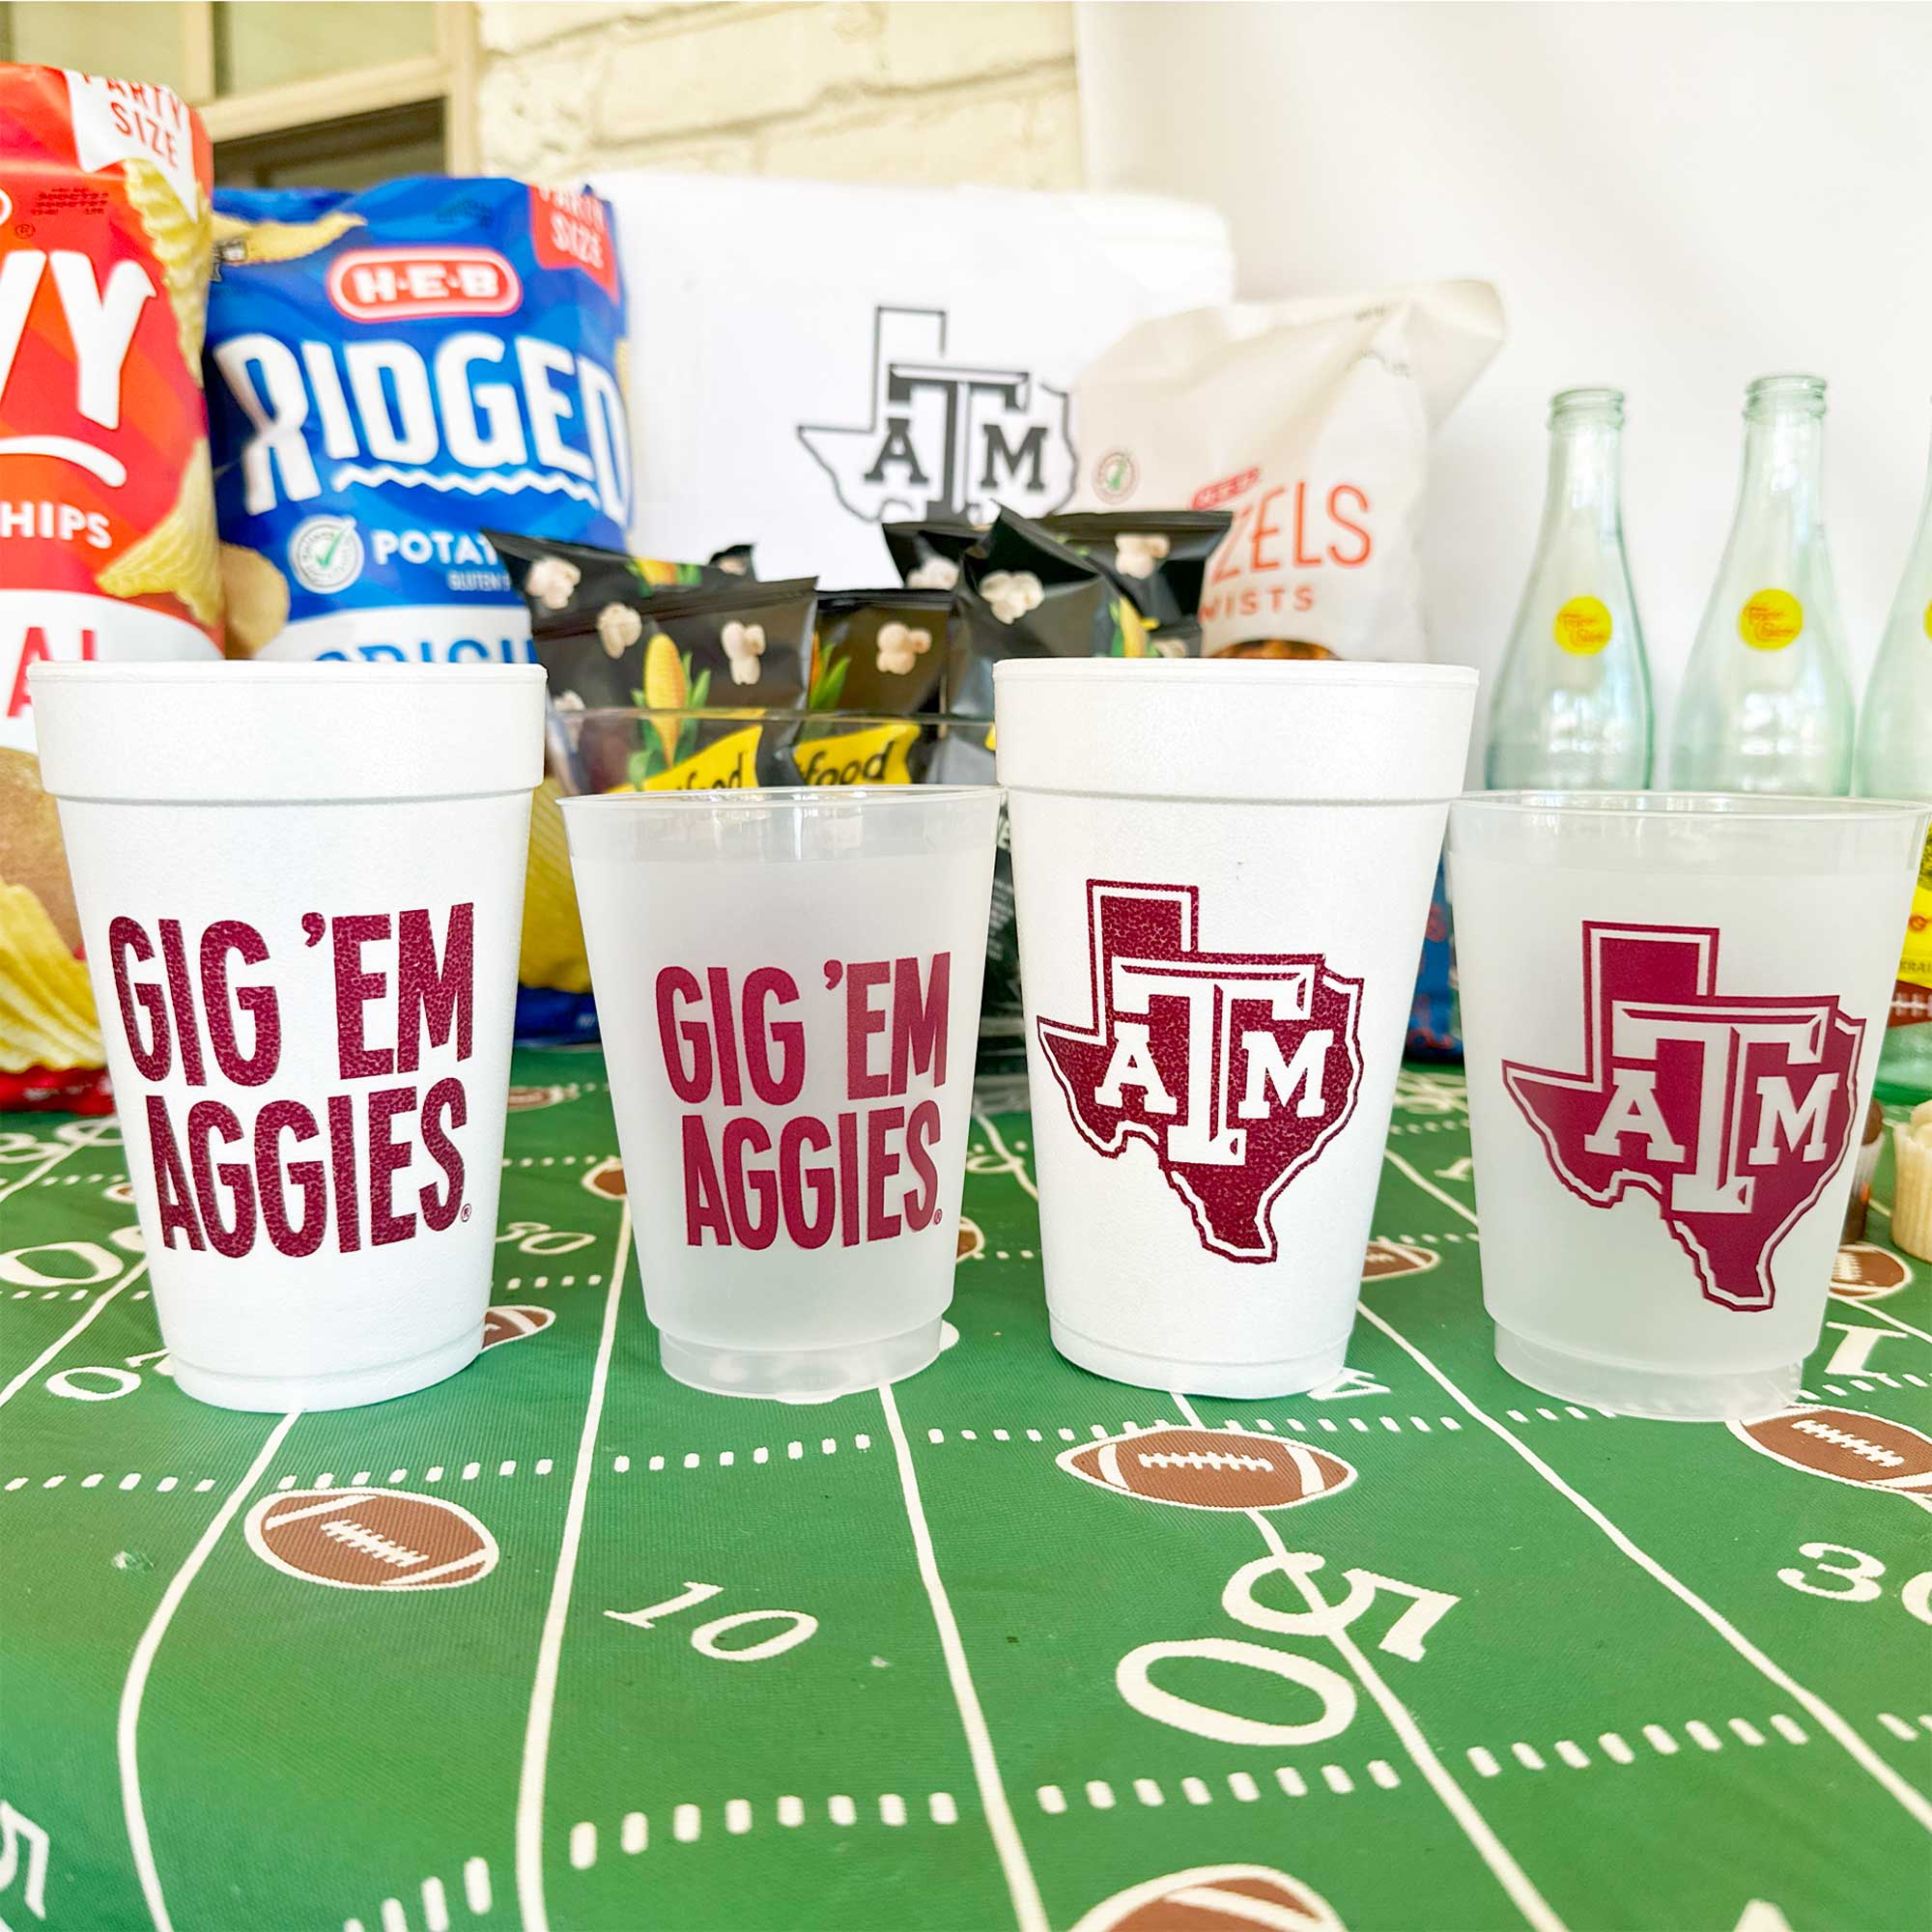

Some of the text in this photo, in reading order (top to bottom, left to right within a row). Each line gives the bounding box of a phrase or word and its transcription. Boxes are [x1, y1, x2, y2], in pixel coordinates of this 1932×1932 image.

[80, 71, 185, 132] ARTY
[109, 100, 180, 170] SIZE
[213, 332, 634, 528] RIDGED
[109, 902, 474, 1087] GIG 'EM
[656, 952, 951, 1106] GIG 'EM
[604, 1581, 819, 1662] 10
